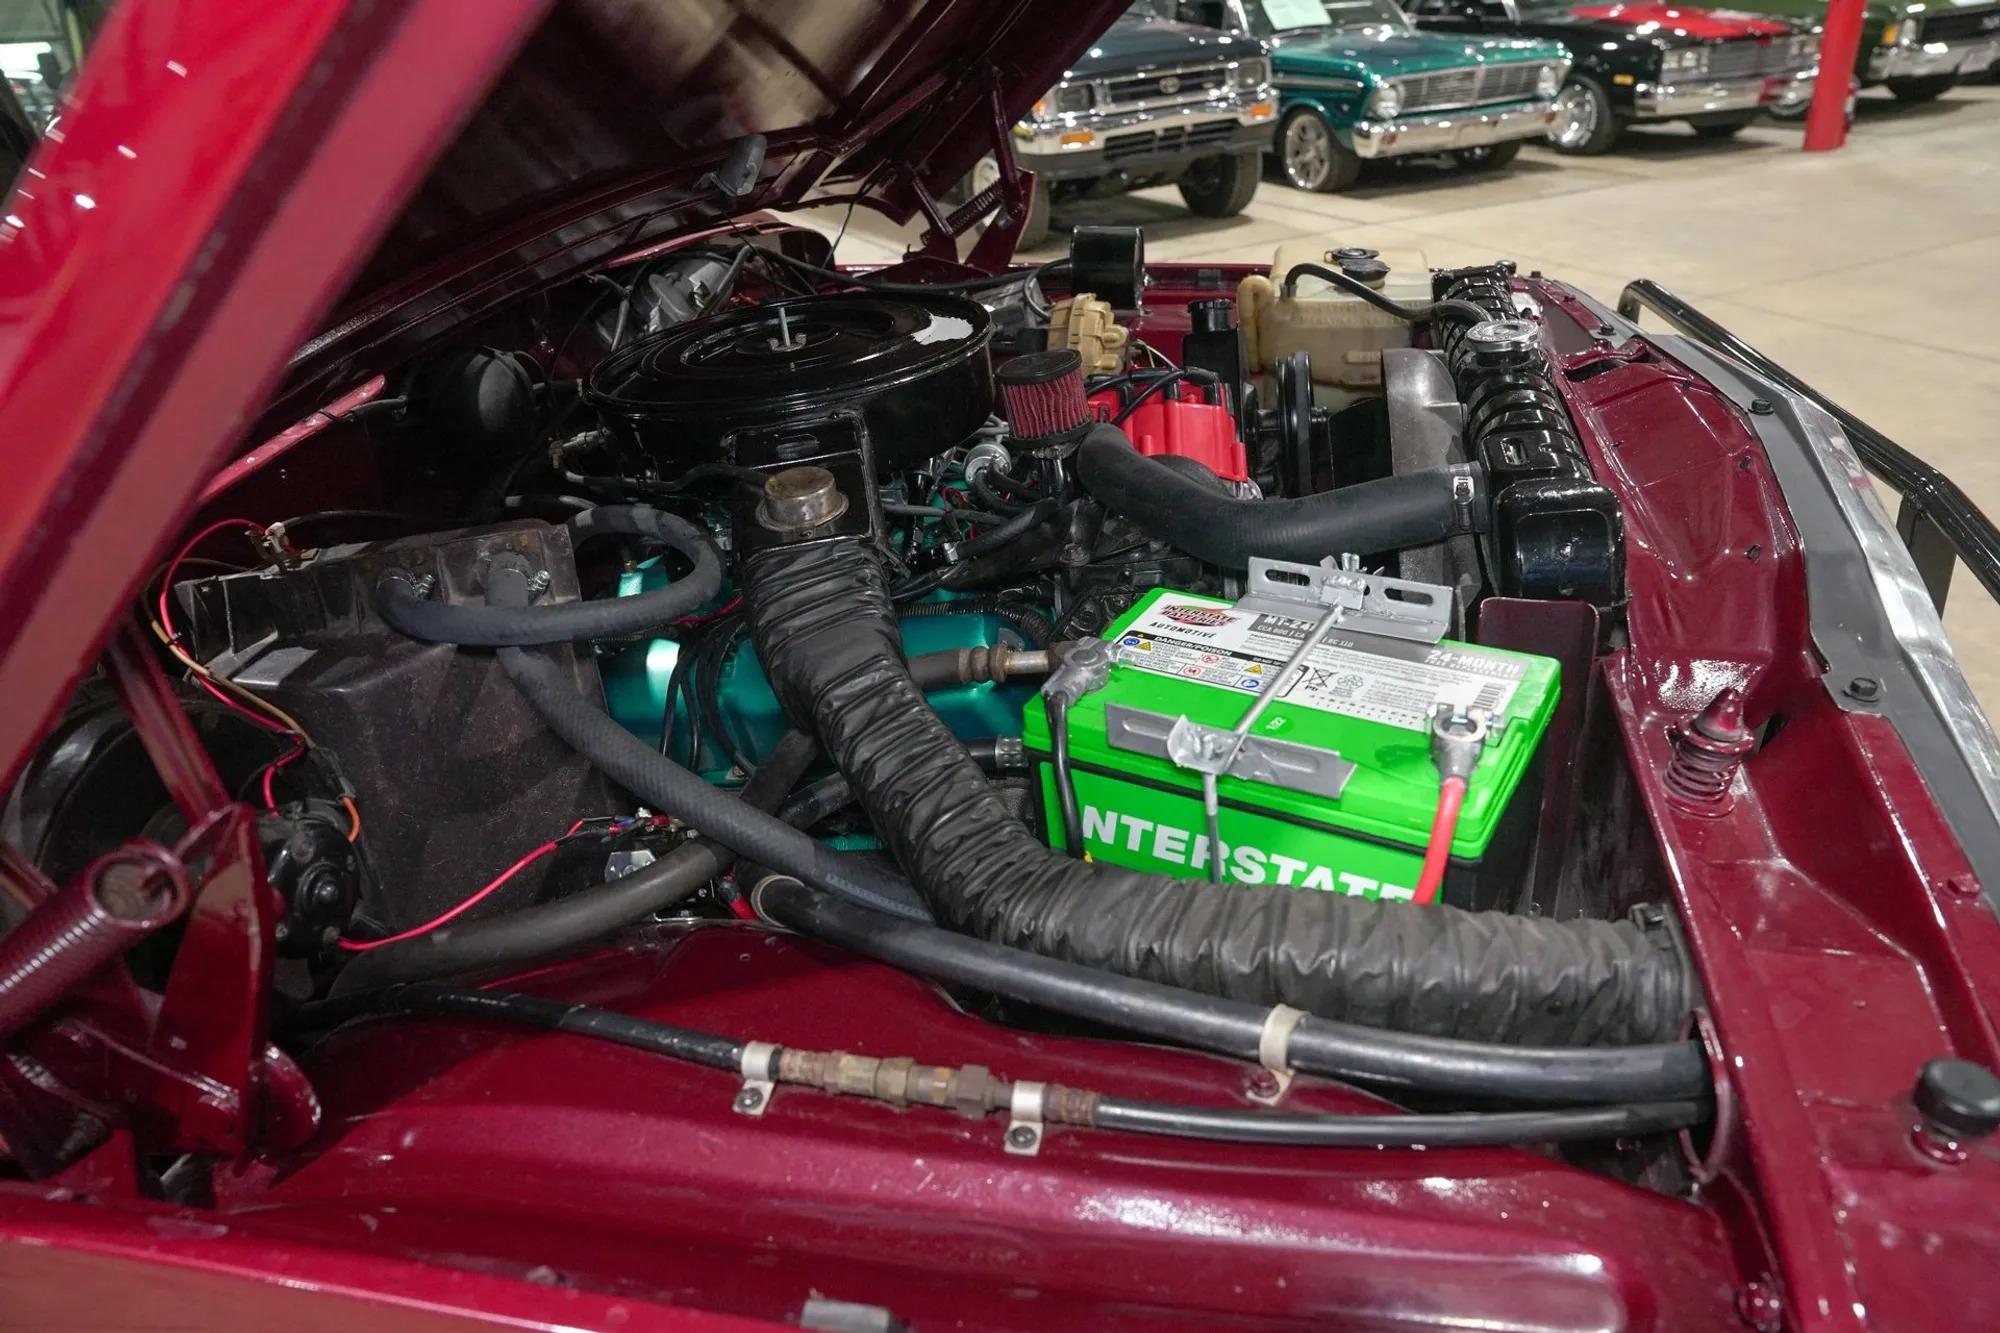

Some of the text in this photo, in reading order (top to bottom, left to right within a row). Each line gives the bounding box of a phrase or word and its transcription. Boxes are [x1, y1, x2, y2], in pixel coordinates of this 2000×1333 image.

[1161, 610, 1226, 627] BATTERIES
[1164, 604, 1236, 623] INTERSTATE
[1149, 621, 1217, 639] AUTOMOTIVE
[1154, 636, 1233, 657] DANGER/POISON
[1427, 649, 1521, 674] 24-MONTH
[1082, 804, 1416, 902] NTERSTAT
